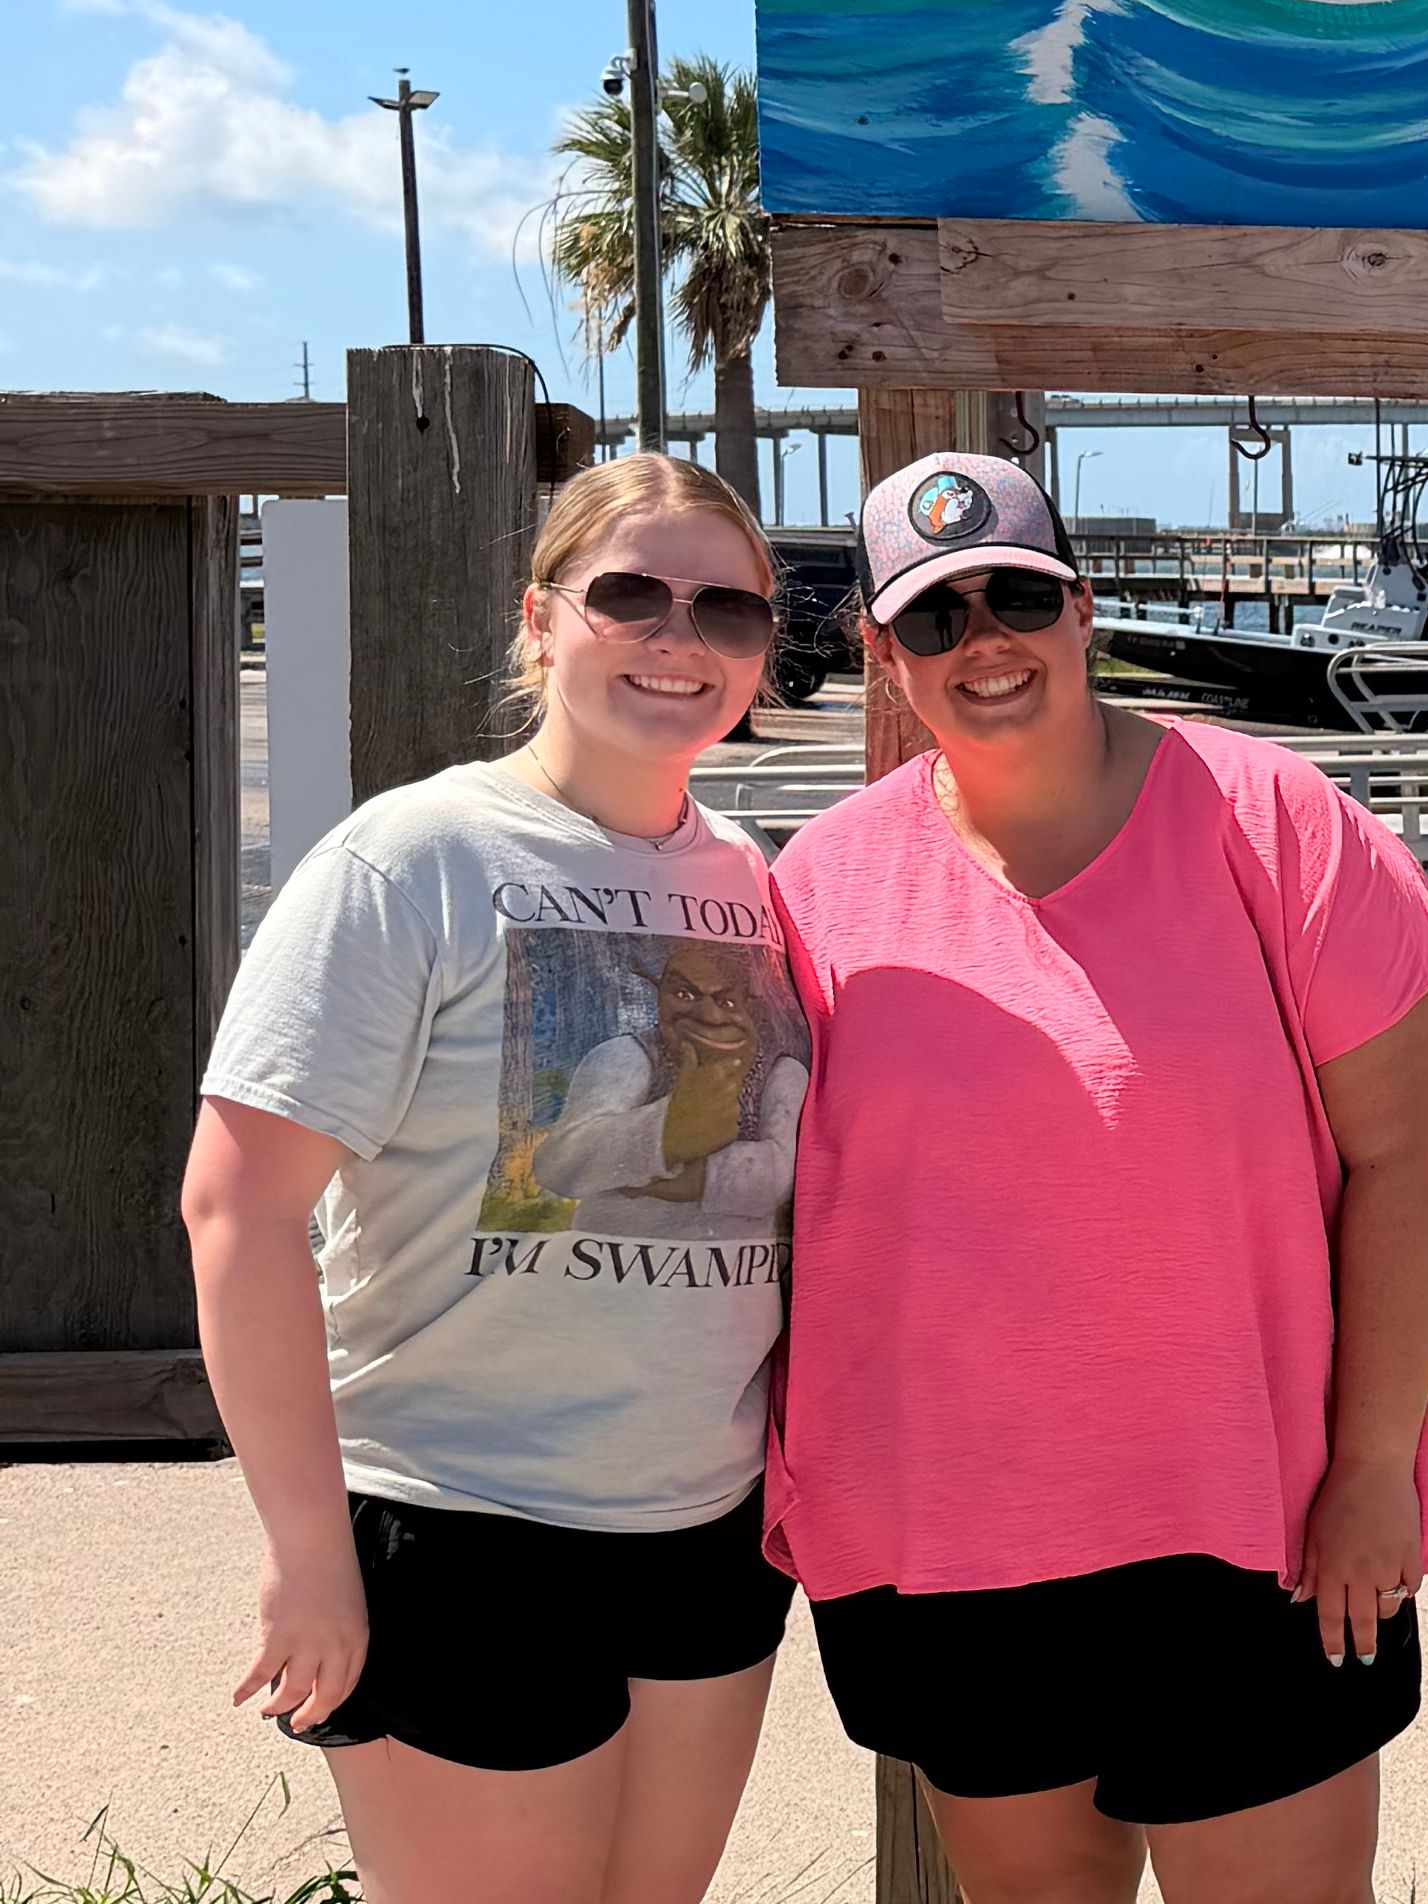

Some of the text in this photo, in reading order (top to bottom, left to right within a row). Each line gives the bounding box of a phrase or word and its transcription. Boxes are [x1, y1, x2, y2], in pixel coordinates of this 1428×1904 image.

[492, 882, 782, 946] CAN'T TODA
[464, 1237, 792, 1288] I'M SWAMP
